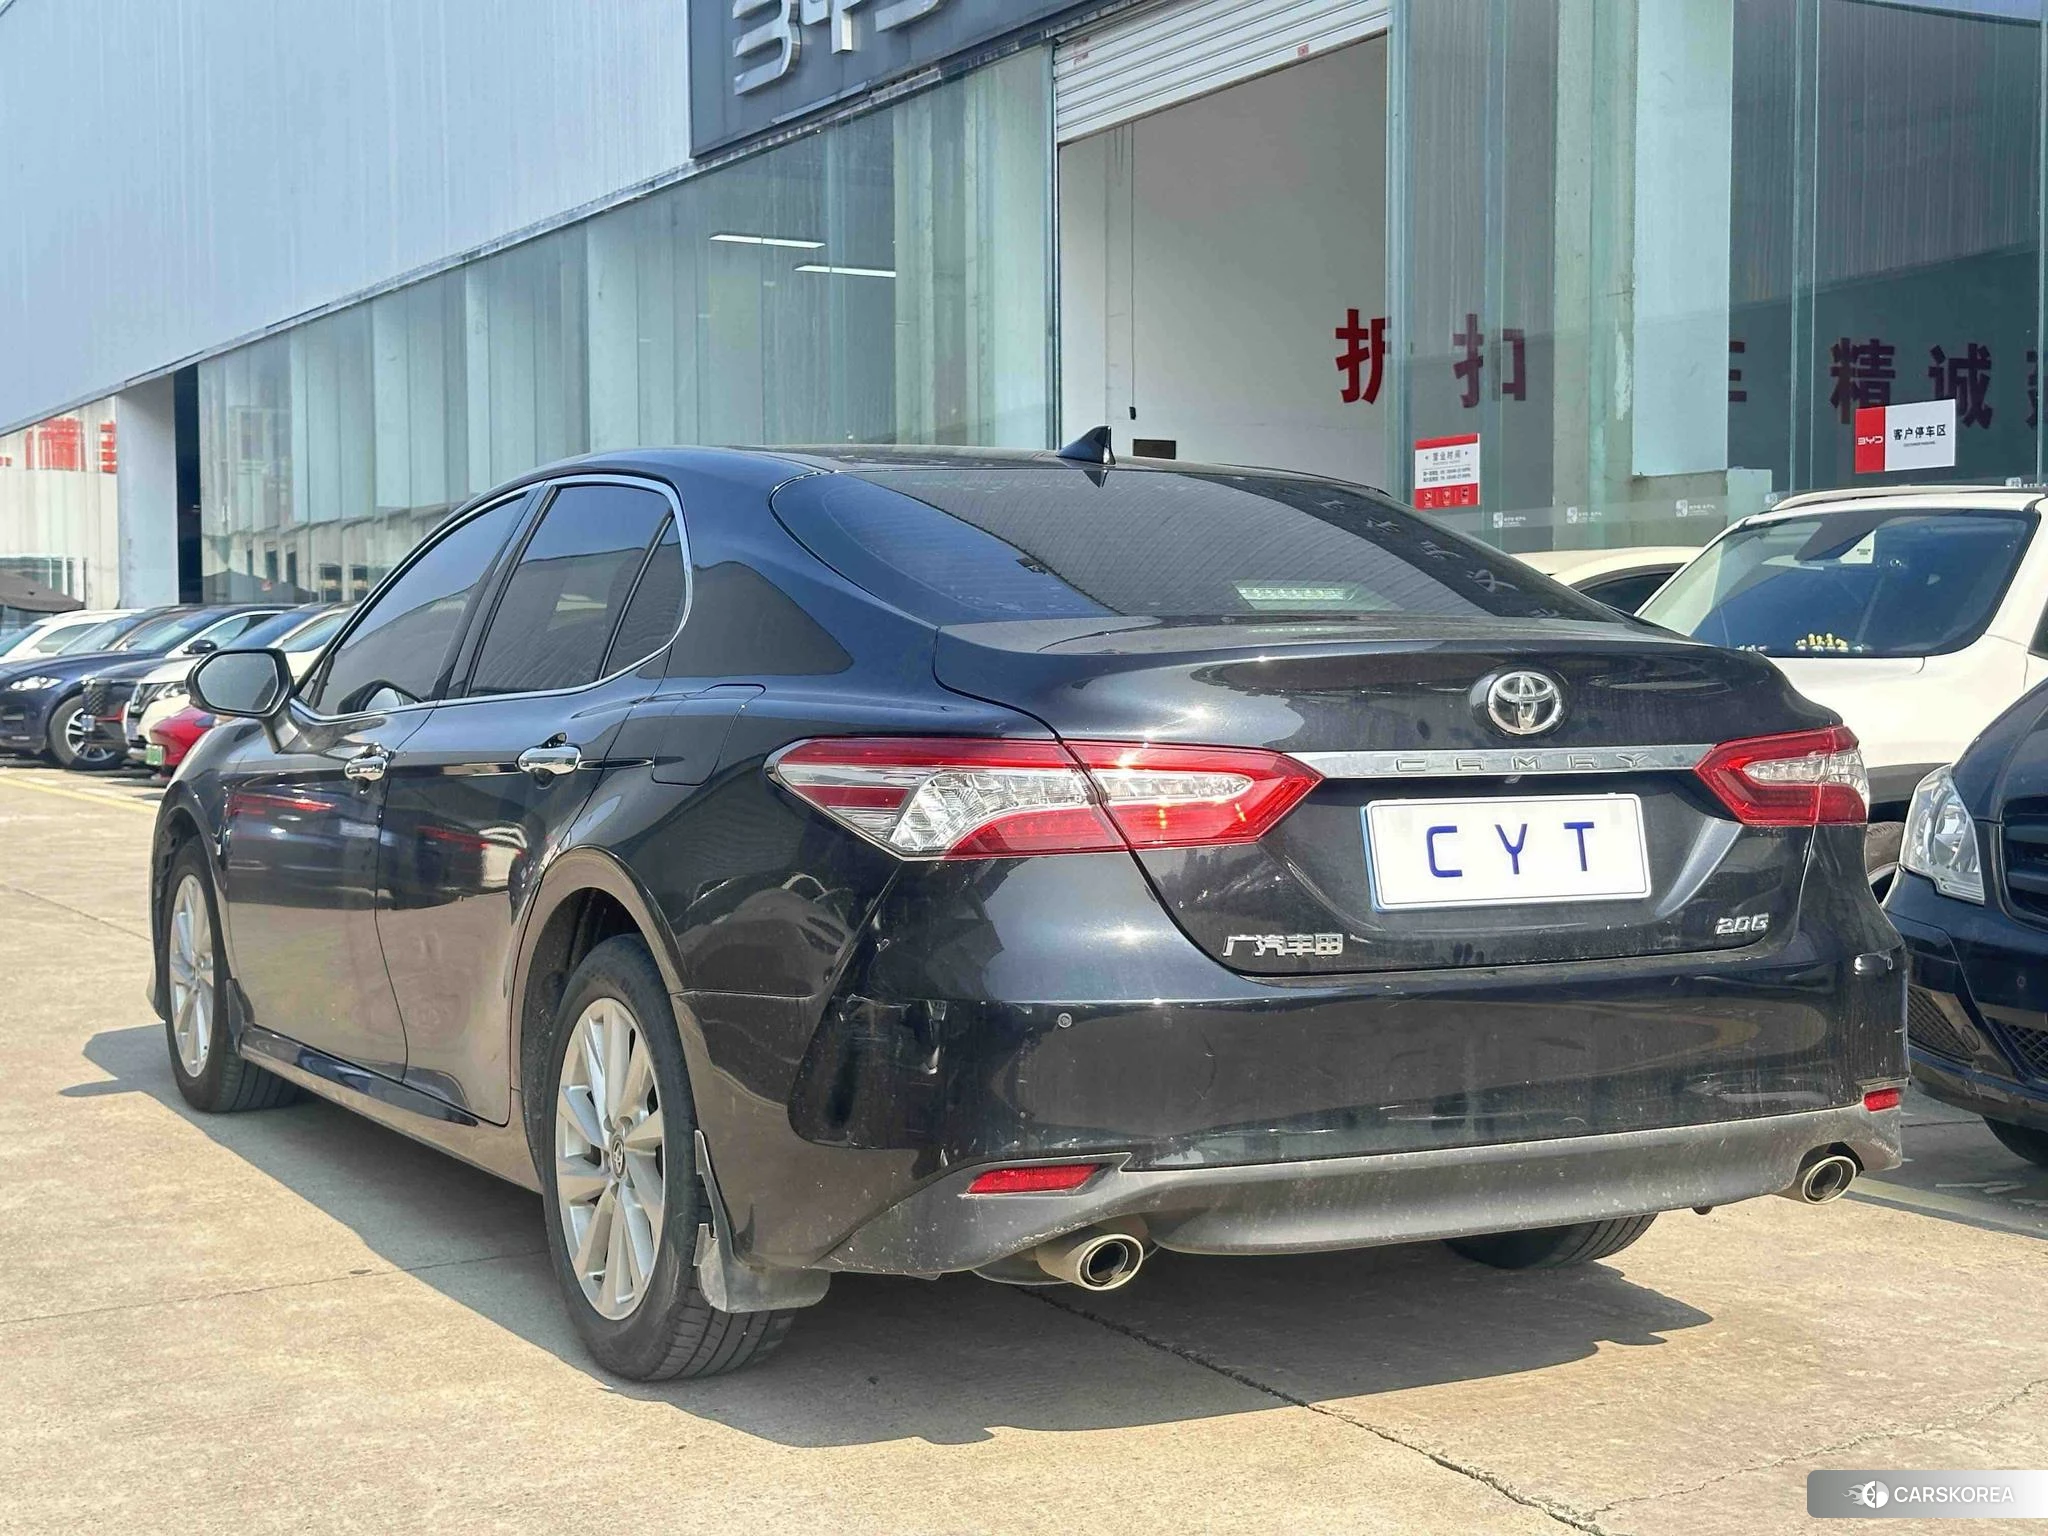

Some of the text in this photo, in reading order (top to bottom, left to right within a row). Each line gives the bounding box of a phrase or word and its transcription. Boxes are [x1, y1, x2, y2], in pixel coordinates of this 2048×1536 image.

[1857, 435, 1884, 446] BYD
[1893, 424, 1946, 441] 客户停车区
[1395, 753, 1649, 773] CAMRY
[1715, 912, 1769, 935] 20G
[1221, 933, 1344, 957] 广汽丰田
